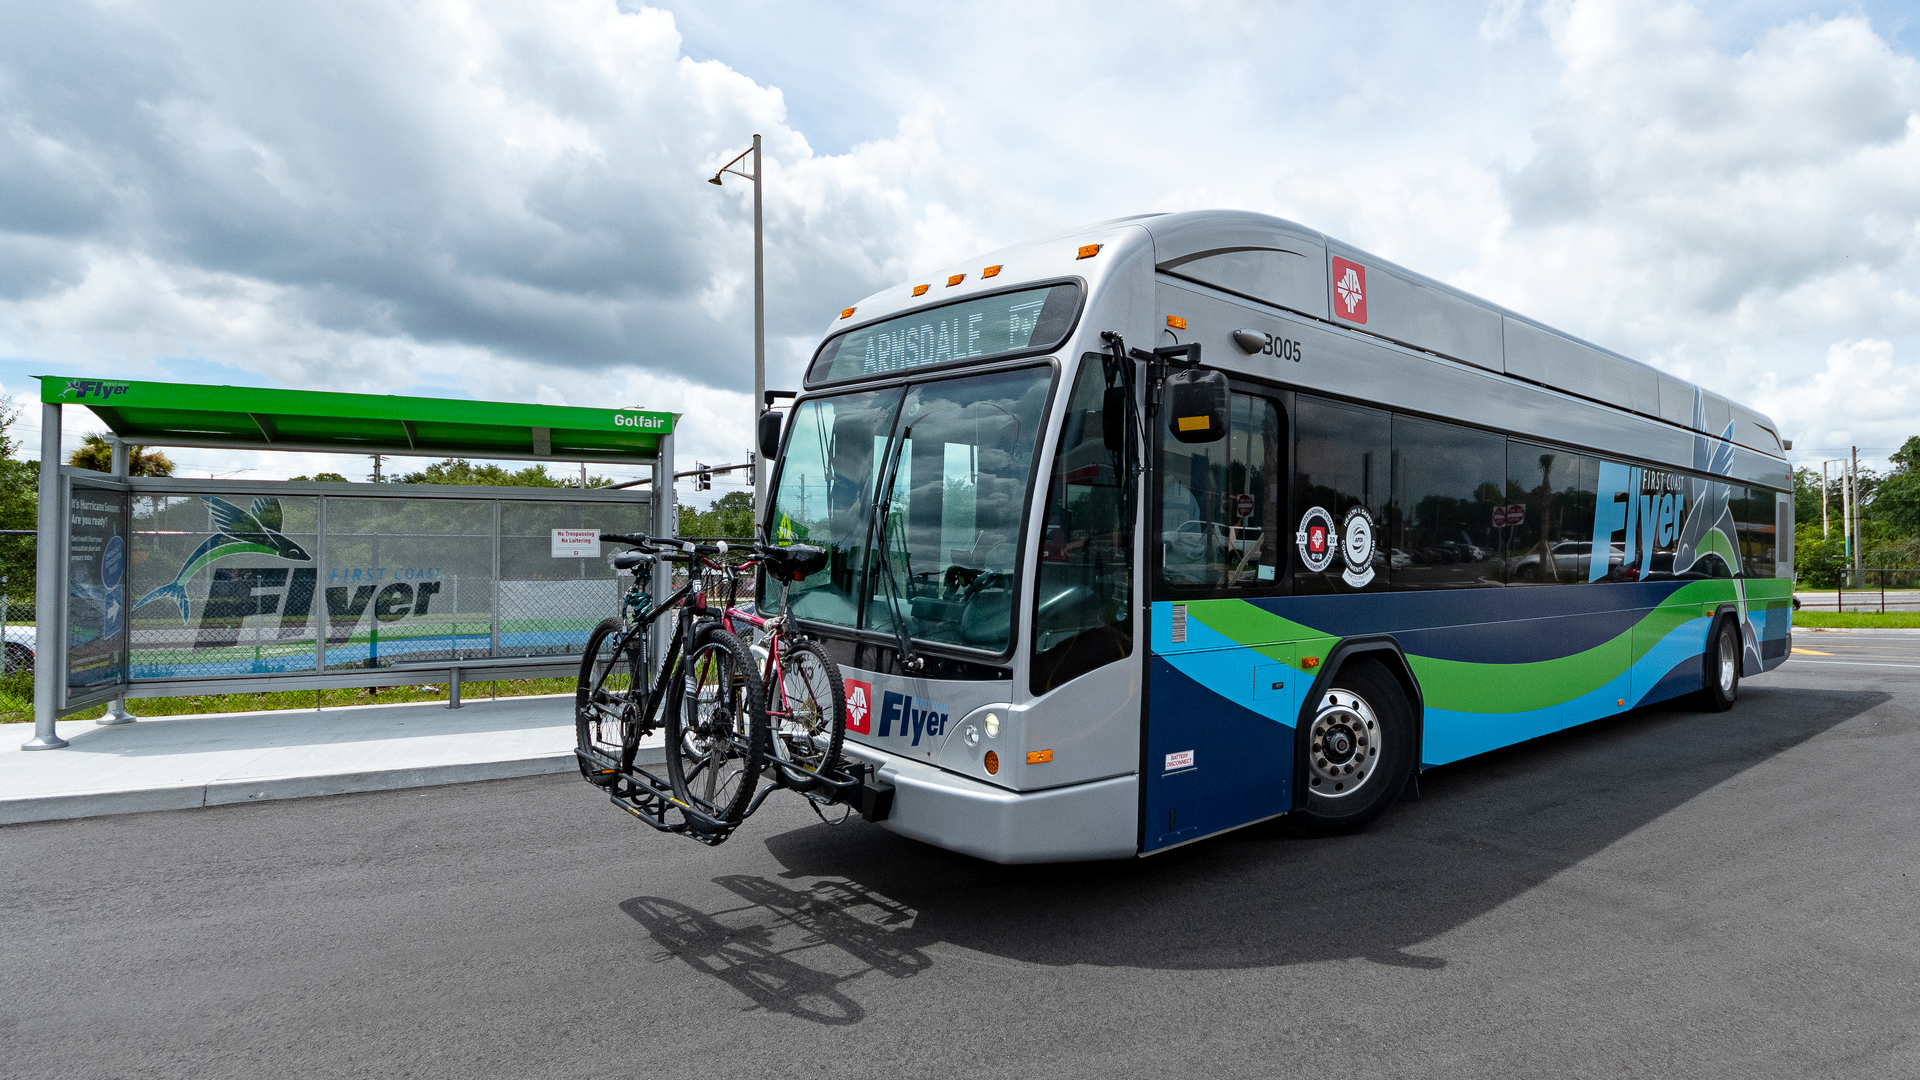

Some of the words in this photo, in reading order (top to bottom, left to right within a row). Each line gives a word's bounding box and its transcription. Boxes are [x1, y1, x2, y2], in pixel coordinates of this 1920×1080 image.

[863, 313, 983, 375] ARMSDALE
[1262, 331, 1301, 362] B005
[75, 380, 129, 399] Flyer
[614, 414, 664, 428] Golfair
[1642, 469, 1665, 490] FIRST
[1666, 473, 1684, 491] COAST
[80, 500, 105, 511] Hurricane
[71, 513, 81, 525] Are
[81, 516, 91, 527] you
[1588, 460, 1683, 584] Flyer
[330, 568, 387, 583] FIRST
[394, 567, 441, 581] COAST
[193, 567, 441, 649] Flyer
[912, 696, 931, 709] FIRST
[932, 701, 949, 712] COAST
[878, 690, 949, 747] Flyer
[1167, 758, 1192, 767] DISCONNECT
